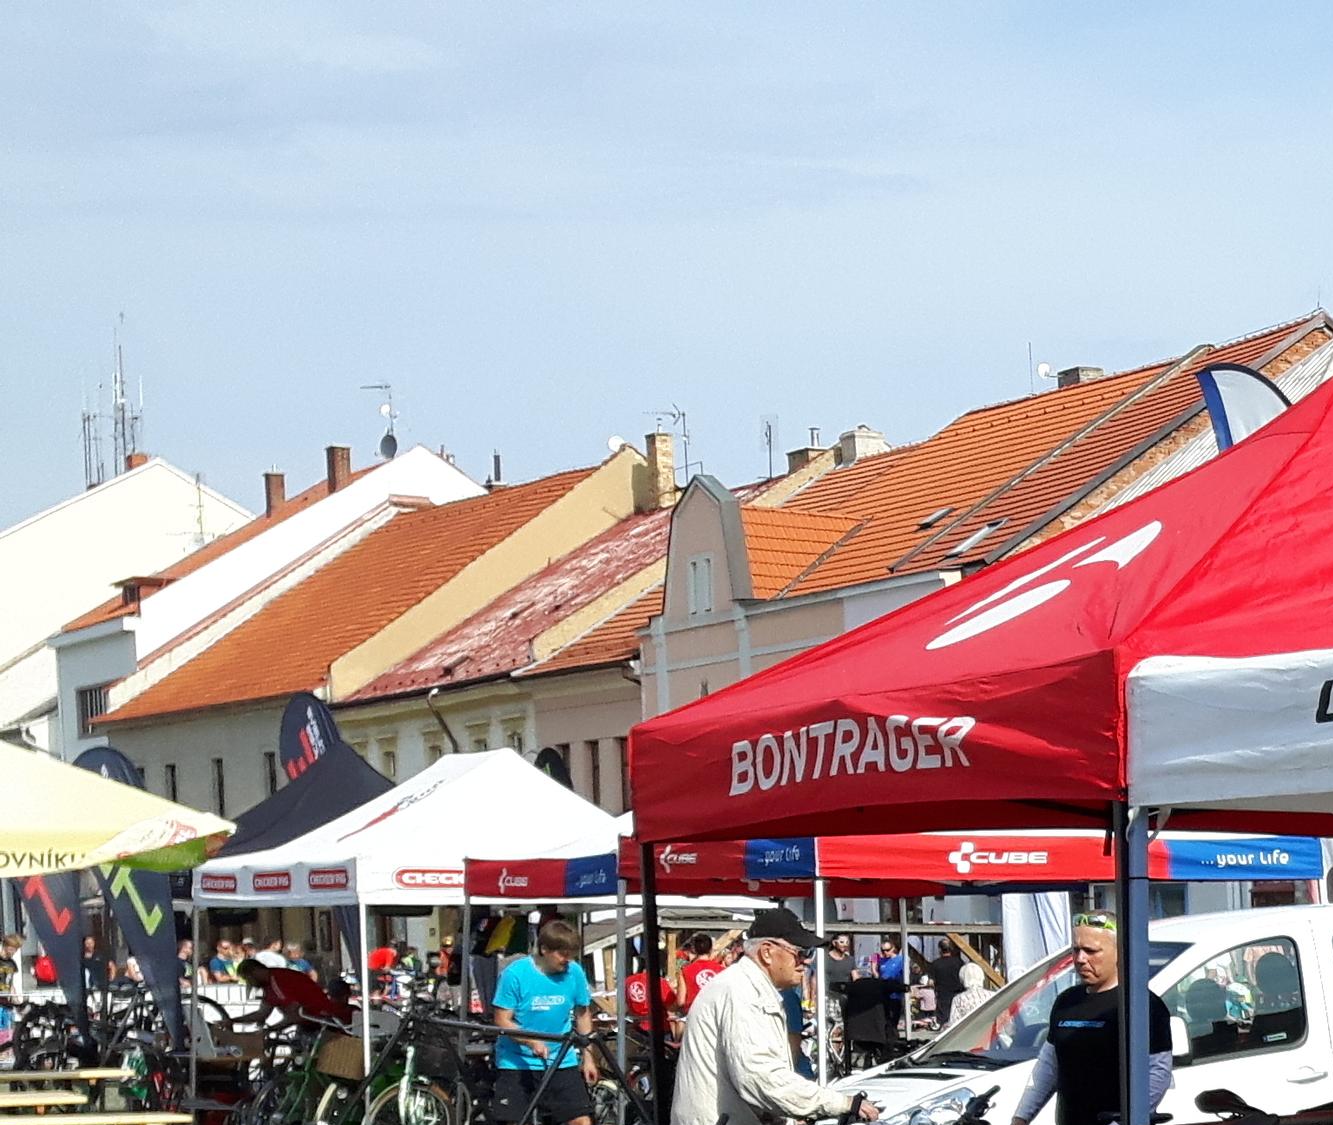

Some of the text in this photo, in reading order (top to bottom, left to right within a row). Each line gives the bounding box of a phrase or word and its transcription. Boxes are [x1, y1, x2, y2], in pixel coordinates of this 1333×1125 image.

[728, 714, 976, 797] BONTRAGER
[0, 848, 84, 869] OVNÍK
[970, 850, 1049, 865] CUBE
